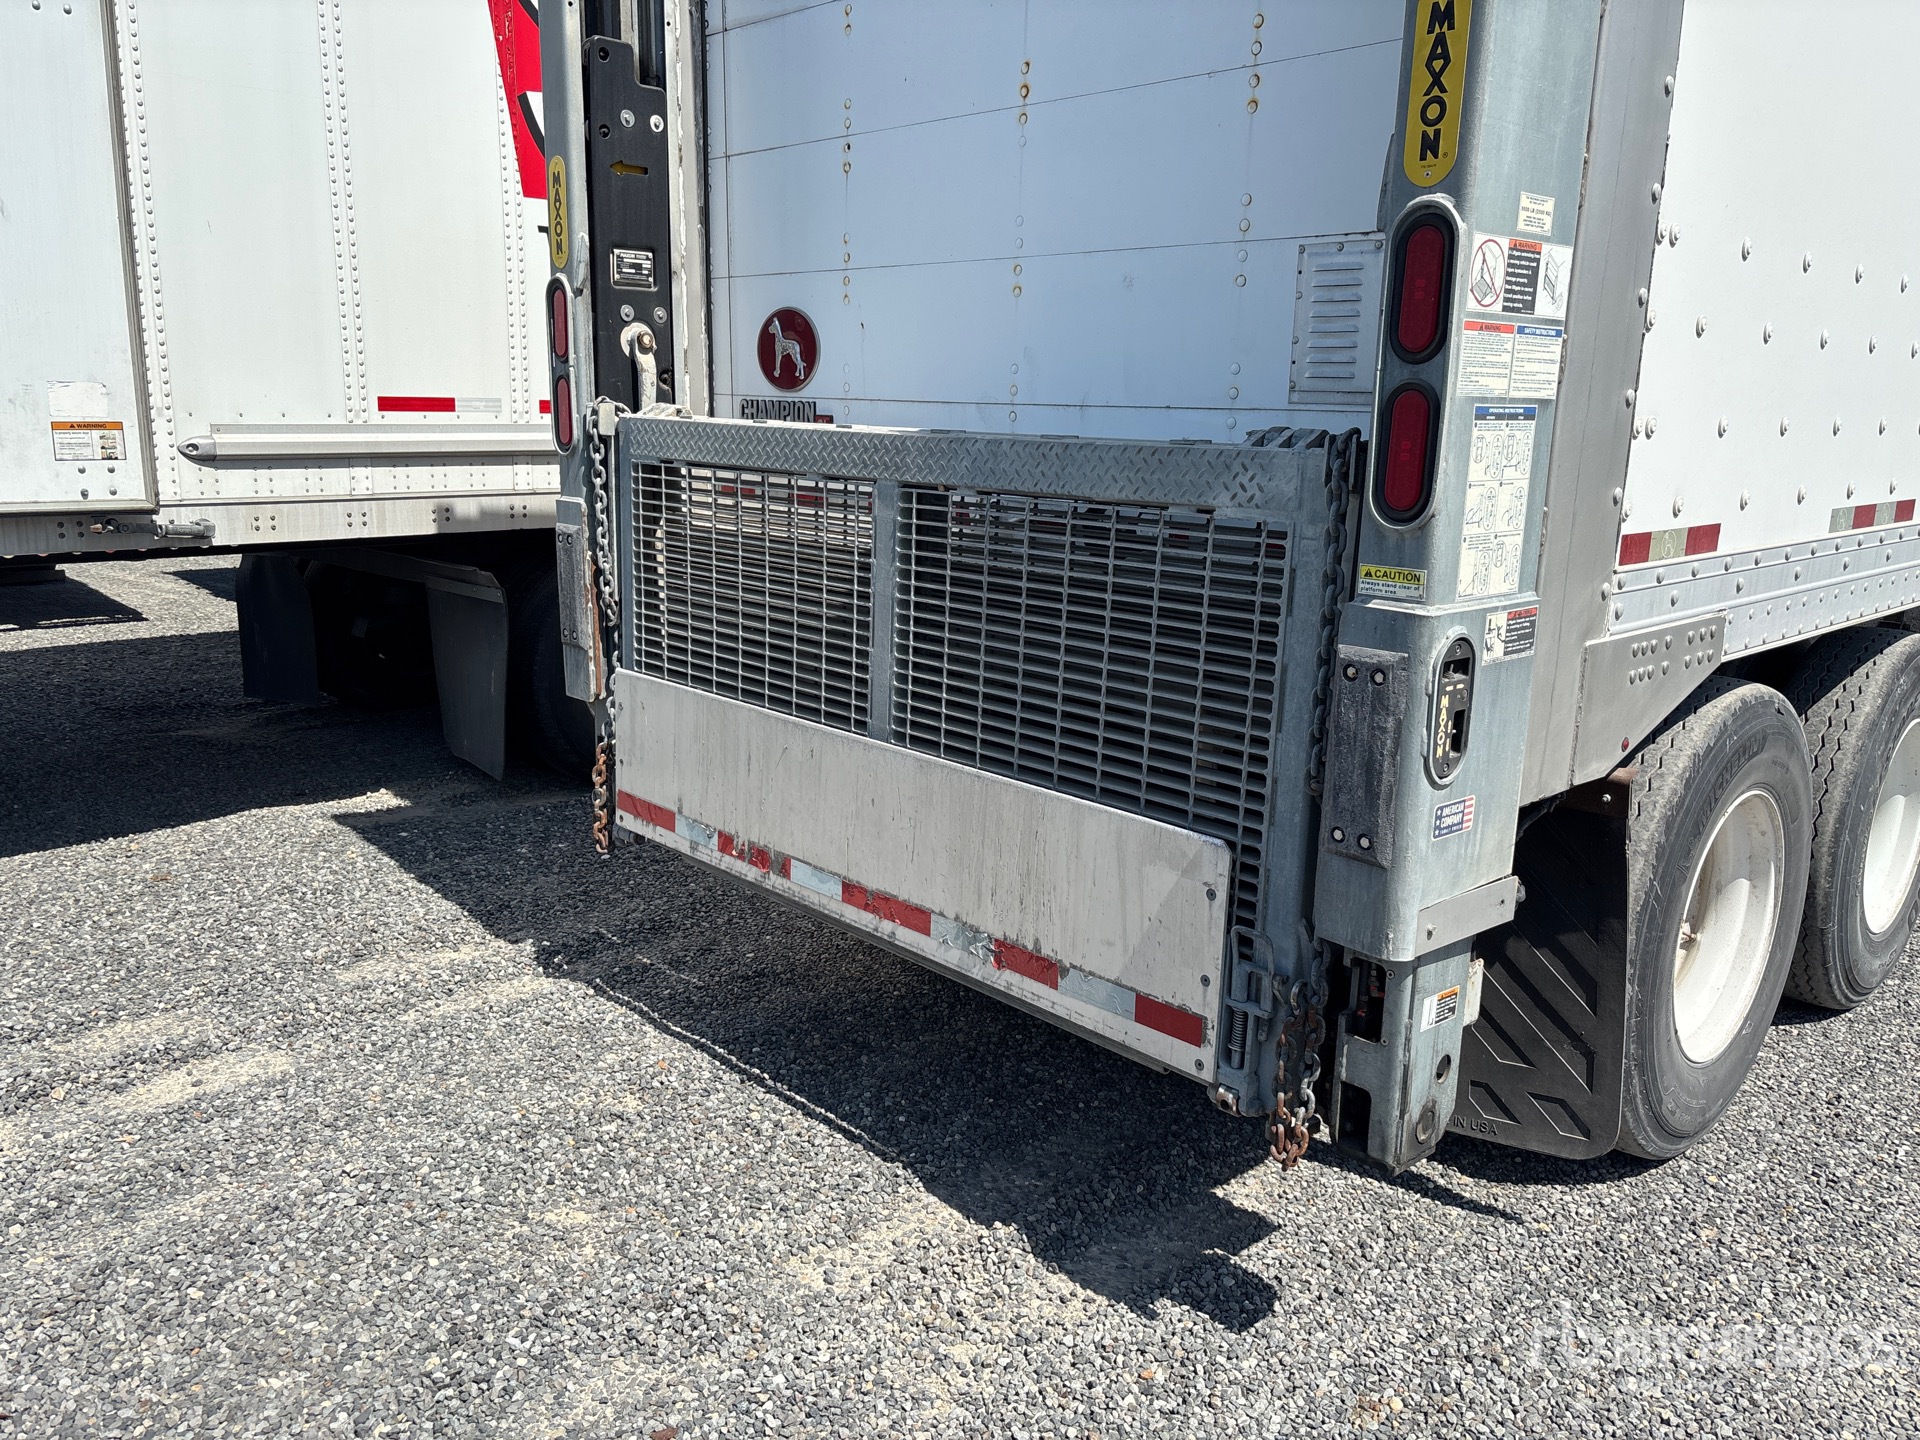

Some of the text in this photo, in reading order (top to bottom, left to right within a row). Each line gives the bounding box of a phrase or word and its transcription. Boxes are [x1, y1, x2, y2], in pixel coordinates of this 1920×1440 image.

[1419, 1, 1456, 161] MAXON
[552, 170, 564, 255] MAXON
[1517, 242, 1537, 250] WARNING
[739, 398, 816, 423] CHAMPION
[1374, 569, 1421, 582] CAUTION
[1436, 694, 1449, 758] MAXON
[1697, 734, 1766, 835] MICHELIN
[1440, 812, 1464, 828] COMPANY
[1442, 802, 1464, 817] AMERICAN
[1453, 1115, 1498, 1136] IN USA
